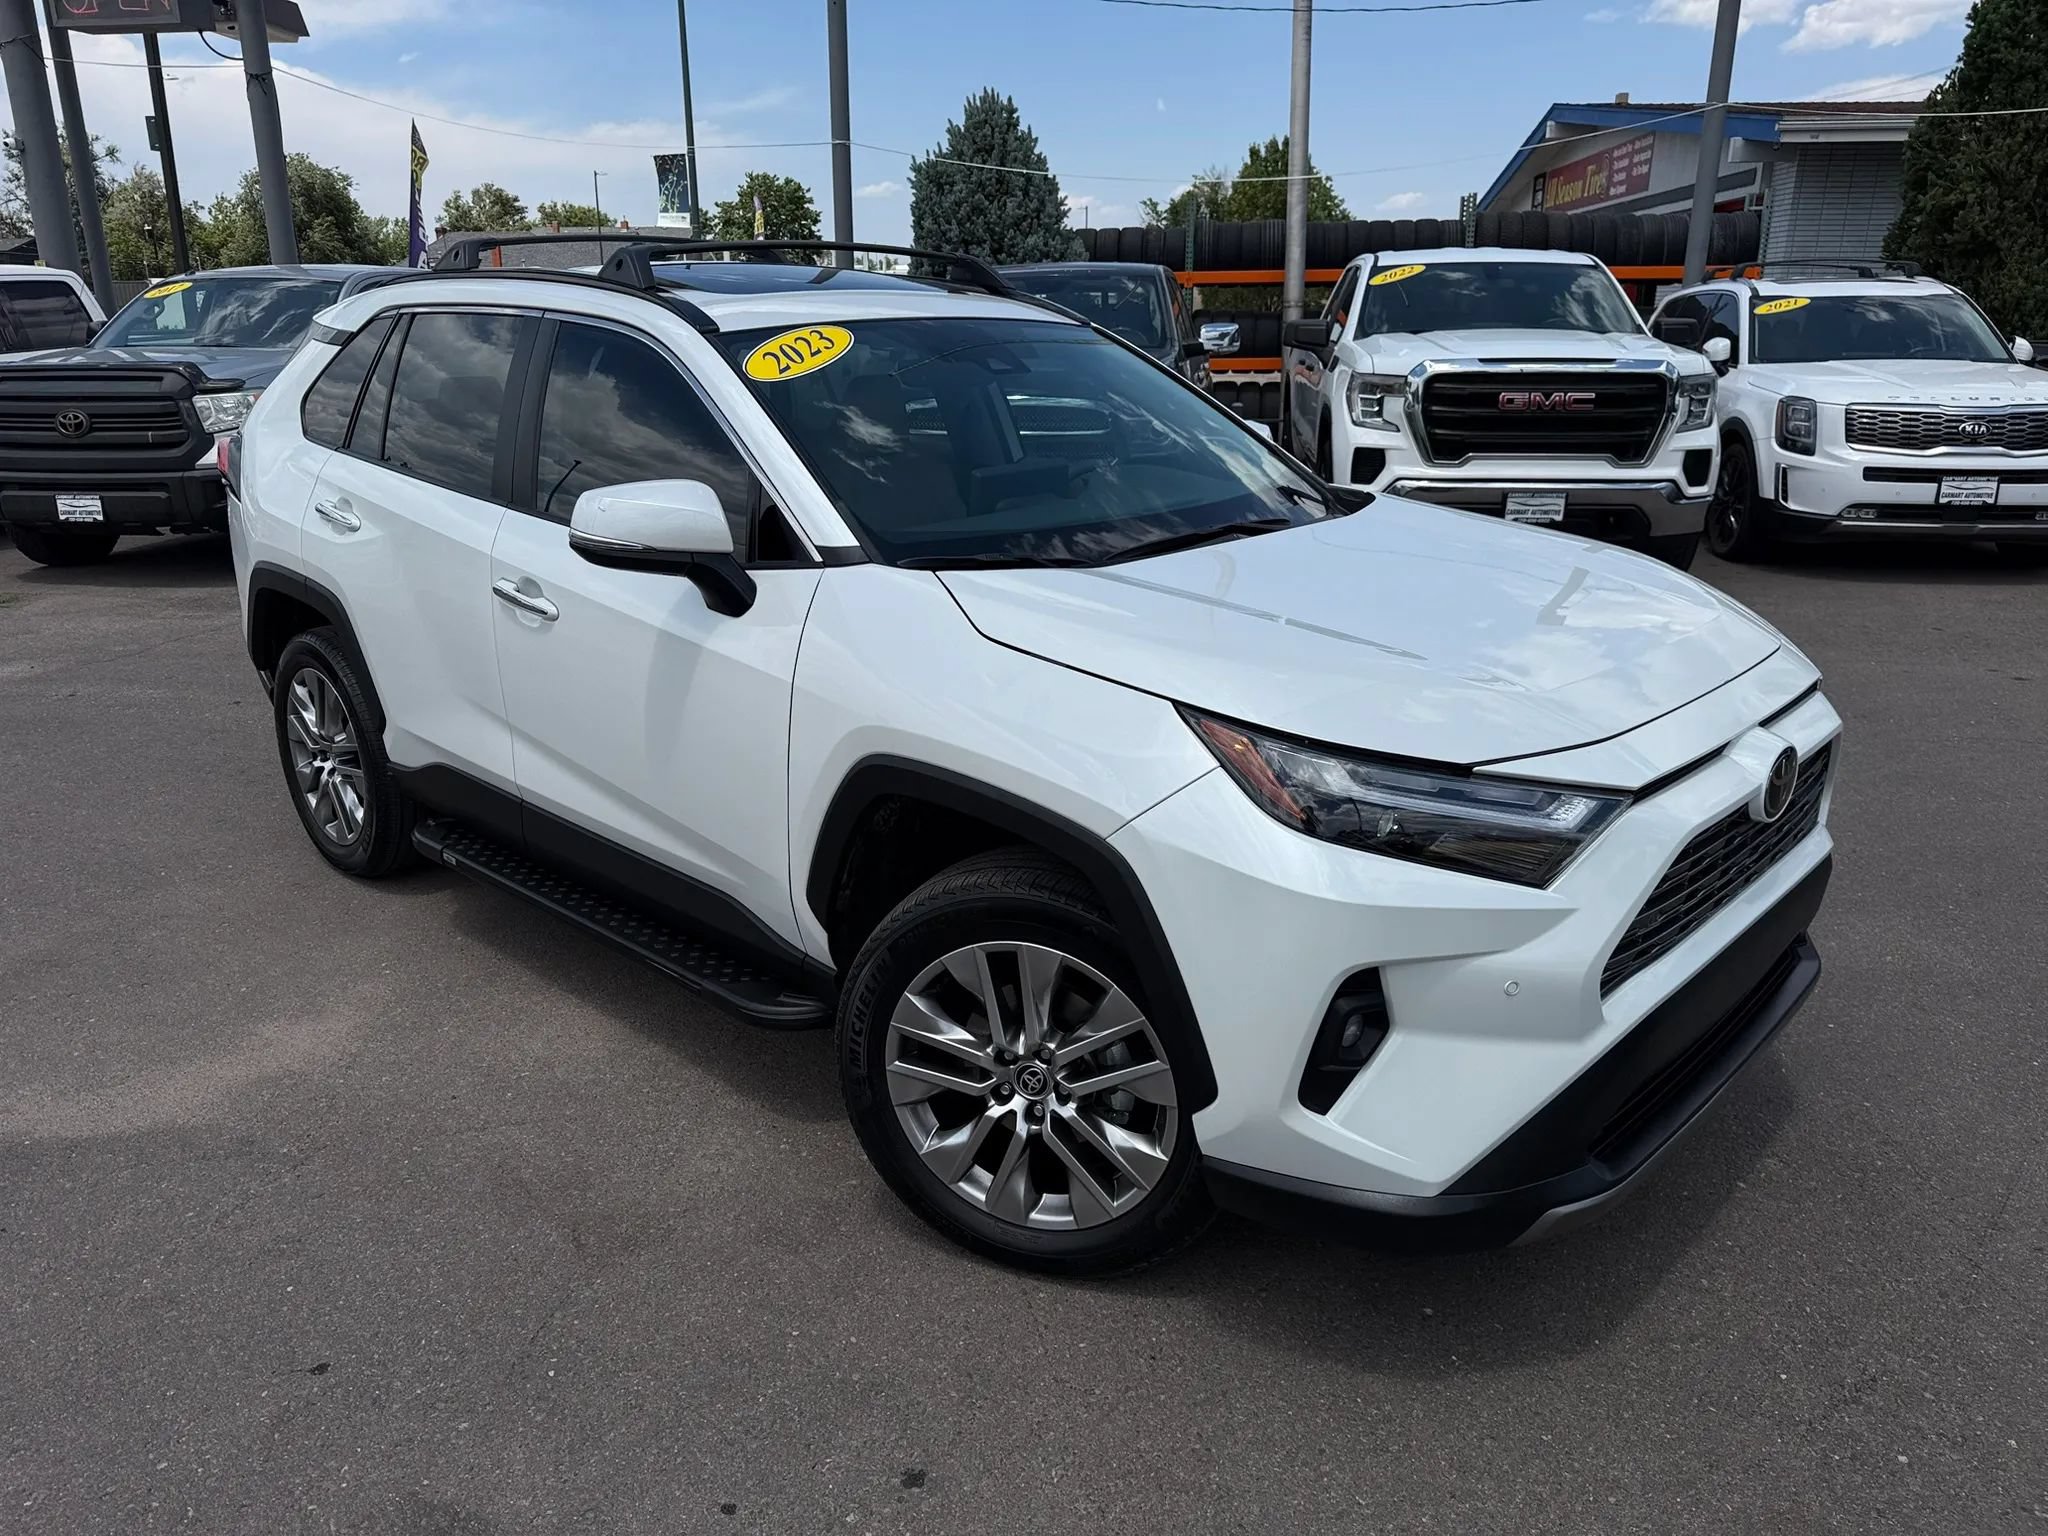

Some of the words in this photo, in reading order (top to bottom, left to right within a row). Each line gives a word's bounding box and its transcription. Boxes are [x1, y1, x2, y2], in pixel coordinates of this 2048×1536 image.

[1556, 175, 1584, 205] Season
[1380, 266, 1415, 282] 2022
[1765, 298, 1798, 312] 2021
[762, 330, 835, 375] 2023
[1498, 392, 1596, 411] GMC
[1965, 424, 1988, 435] KIA
[1941, 491, 1965, 499] CARMART
[1506, 508, 1530, 516] CARMART
[1530, 509, 1562, 517] AUTOMOTIVE
[851, 950, 893, 1070] MICHELIN
